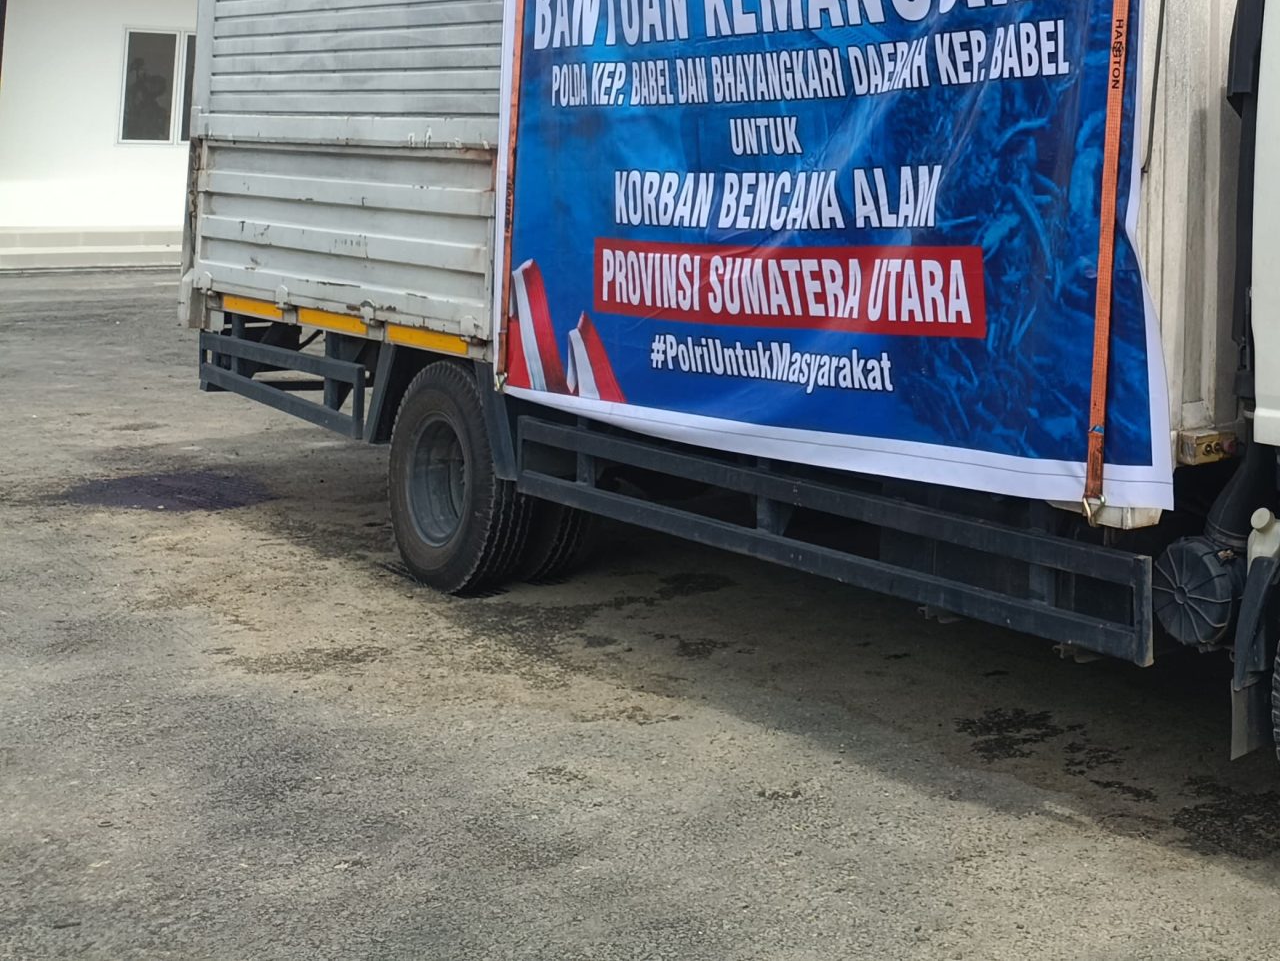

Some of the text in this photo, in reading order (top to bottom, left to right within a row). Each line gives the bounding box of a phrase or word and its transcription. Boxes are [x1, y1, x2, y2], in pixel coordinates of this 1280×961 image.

[551, 19, 1070, 107] POLDA KEP. BABEL DAN BHAYANGKARI DAERAH KEP. BABEL
[729, 116, 803, 156] UNTUK
[614, 164, 943, 231] KORBAN BENCANA ALAM
[601, 247, 971, 325] PROVINSI SUMATERA UTARA
[649, 332, 894, 395] #PolriUntukMasyarakat
